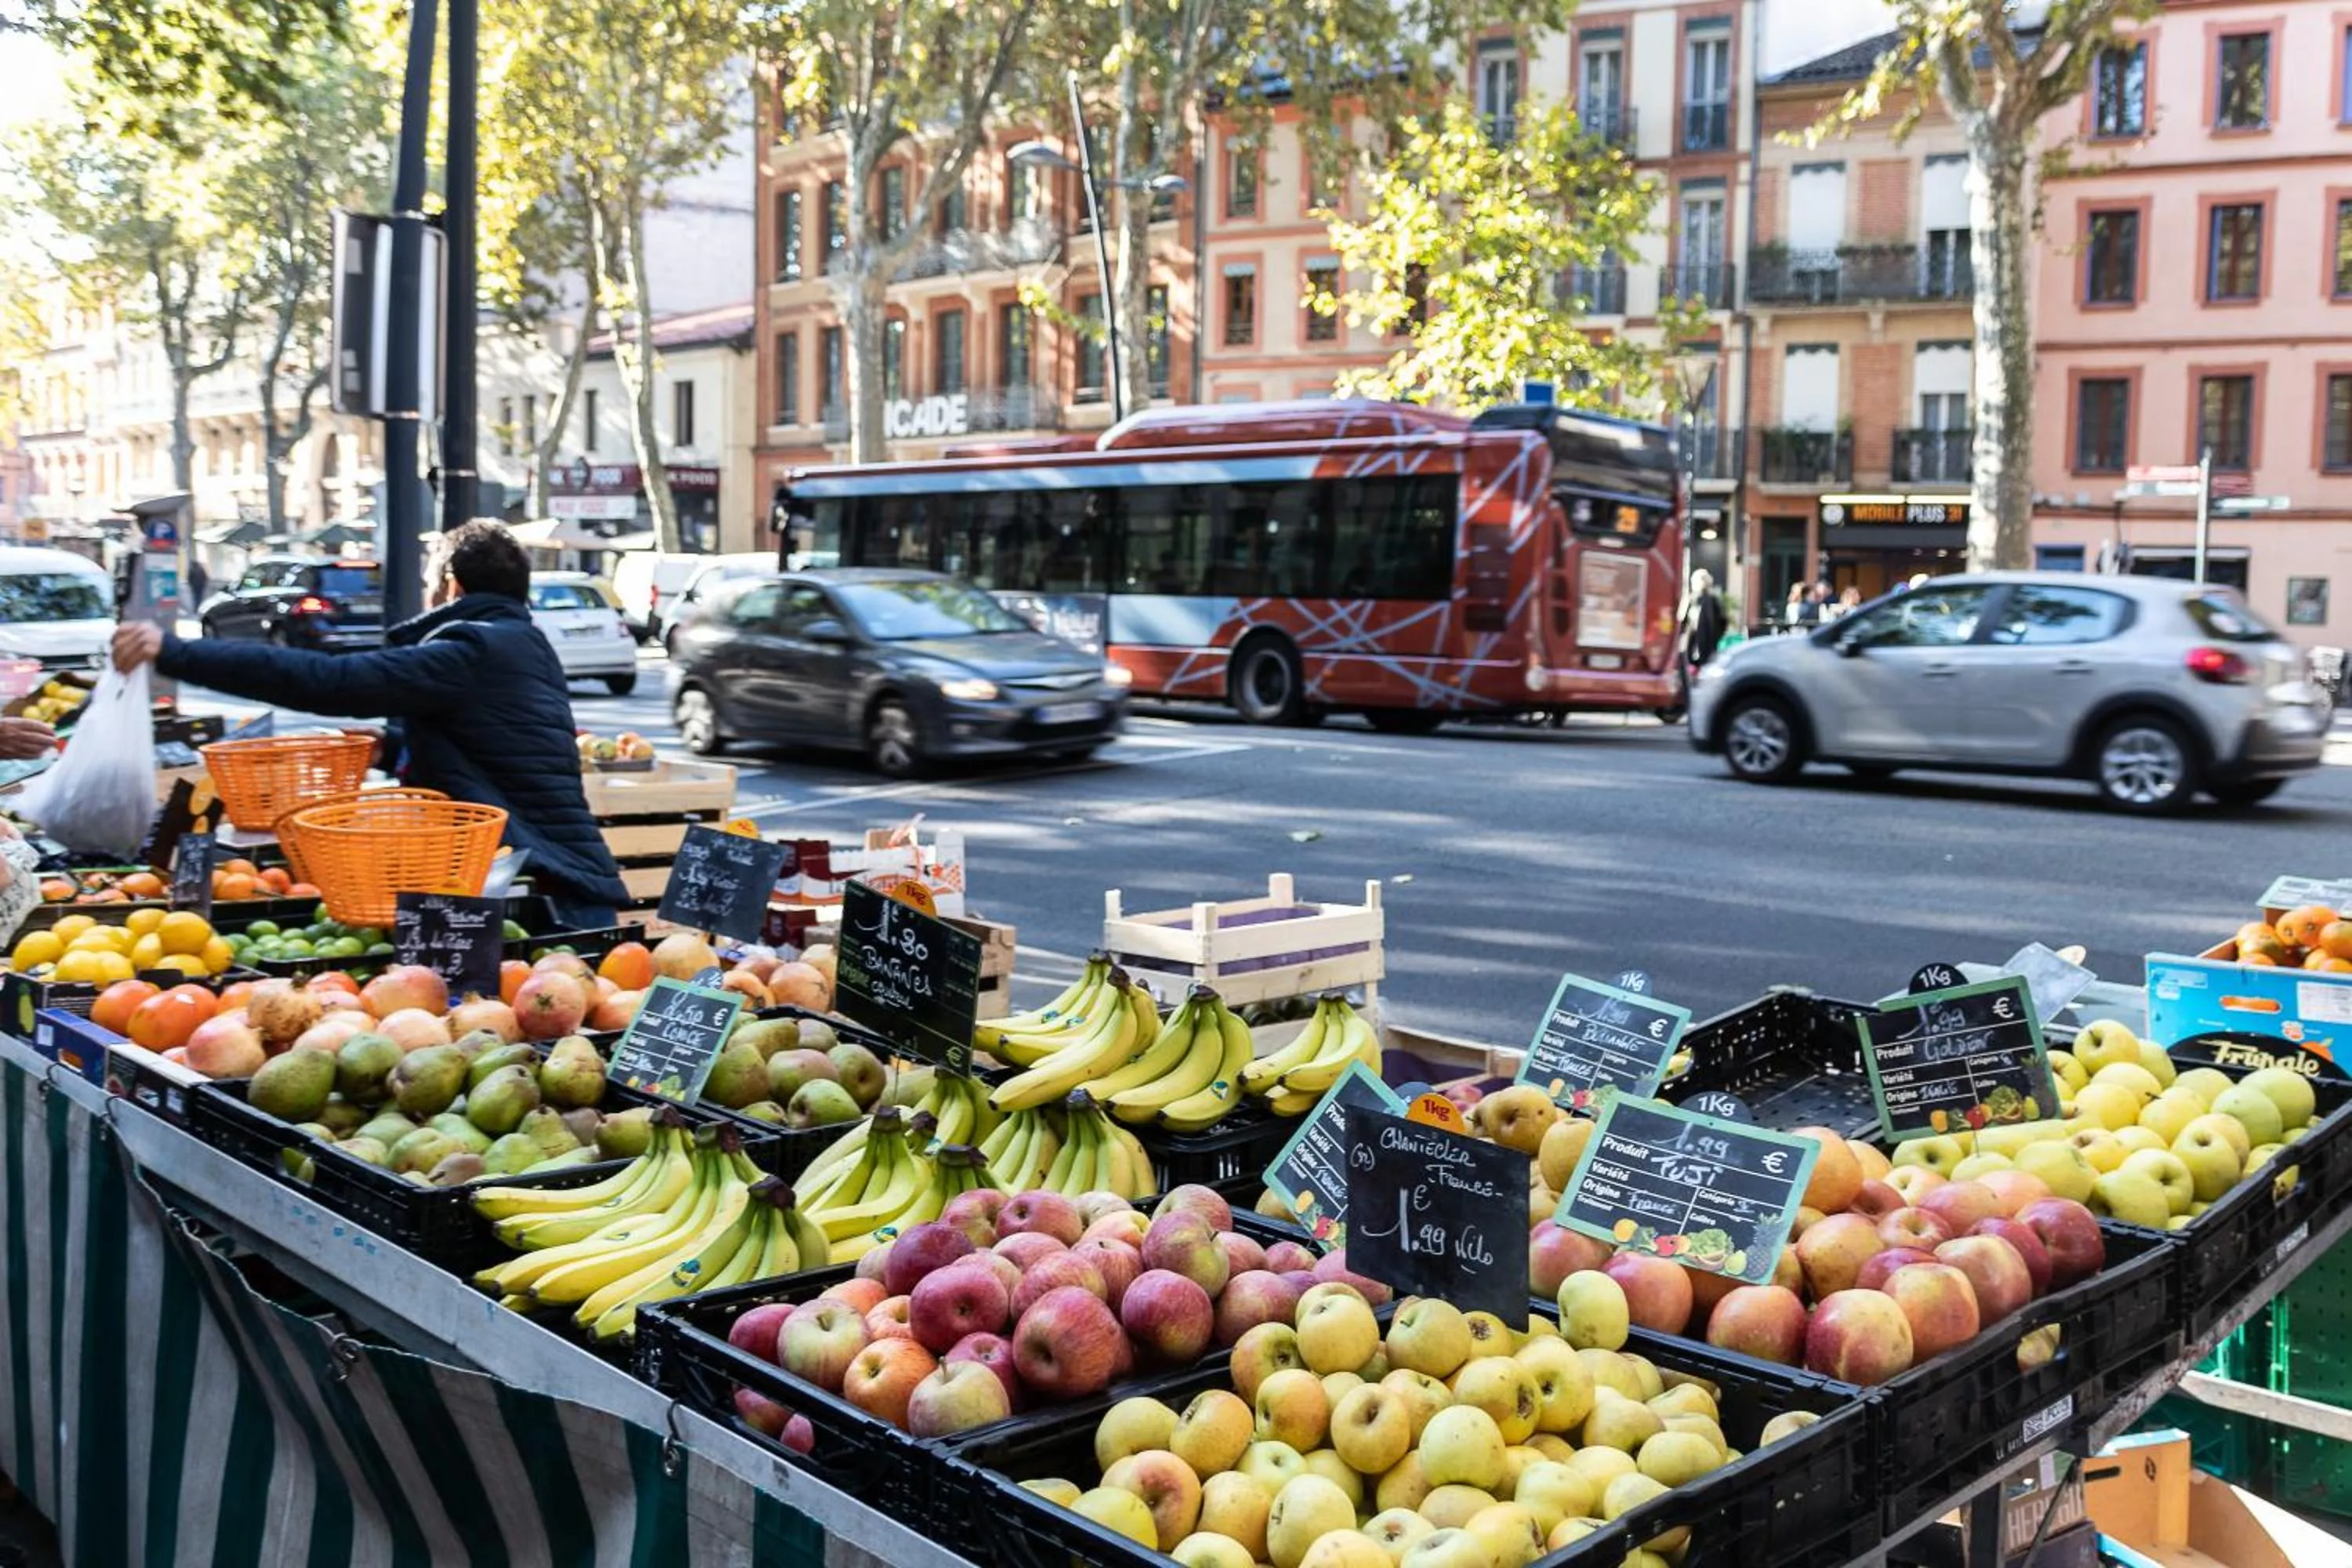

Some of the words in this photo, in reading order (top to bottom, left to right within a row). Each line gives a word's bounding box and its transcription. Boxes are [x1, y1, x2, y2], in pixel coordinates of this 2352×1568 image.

[884, 394, 968, 439] ICADE
[1853, 504, 1906, 523] MOBILE
[1907, 504, 1945, 523] PLUS
[1621, 972, 1645, 993] 1Kg
[1919, 965, 1951, 988] 1Kg
[713, 1007, 728, 1026] €
[1993, 996, 2014, 1018] €
[1649, 1018, 1668, 1038] €
[1876, 1044, 1914, 1060] Produit
[1698, 1094, 1736, 1116] 1Kg
[1886, 1091, 1918, 1103] Origine
[1424, 1099, 1450, 1122] 1kg
[1308, 1127, 1334, 1153] Variété
[1602, 1136, 1650, 1160] Produit
[1296, 1142, 1318, 1169] Origine
[1762, 1152, 1788, 1173] €
[1592, 1162, 1629, 1181] Variété
[1584, 1178, 1621, 1198] Origine
